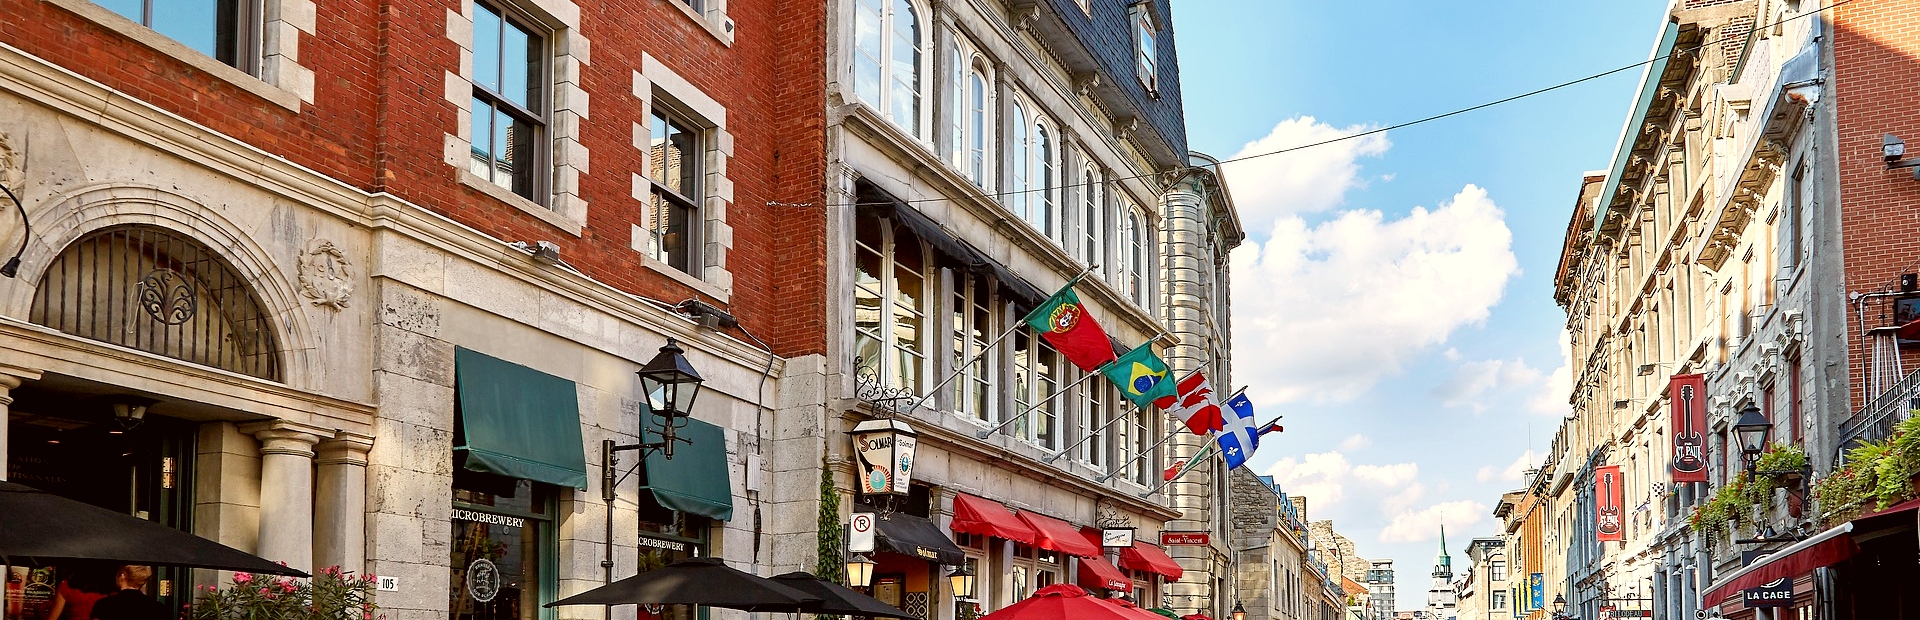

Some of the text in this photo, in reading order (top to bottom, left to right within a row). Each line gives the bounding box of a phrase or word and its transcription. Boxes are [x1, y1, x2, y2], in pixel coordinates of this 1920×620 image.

[859, 433, 893, 452] SOLMAR
[382, 578, 394, 589] 105
[1747, 591, 1791, 600] LA CAGE
